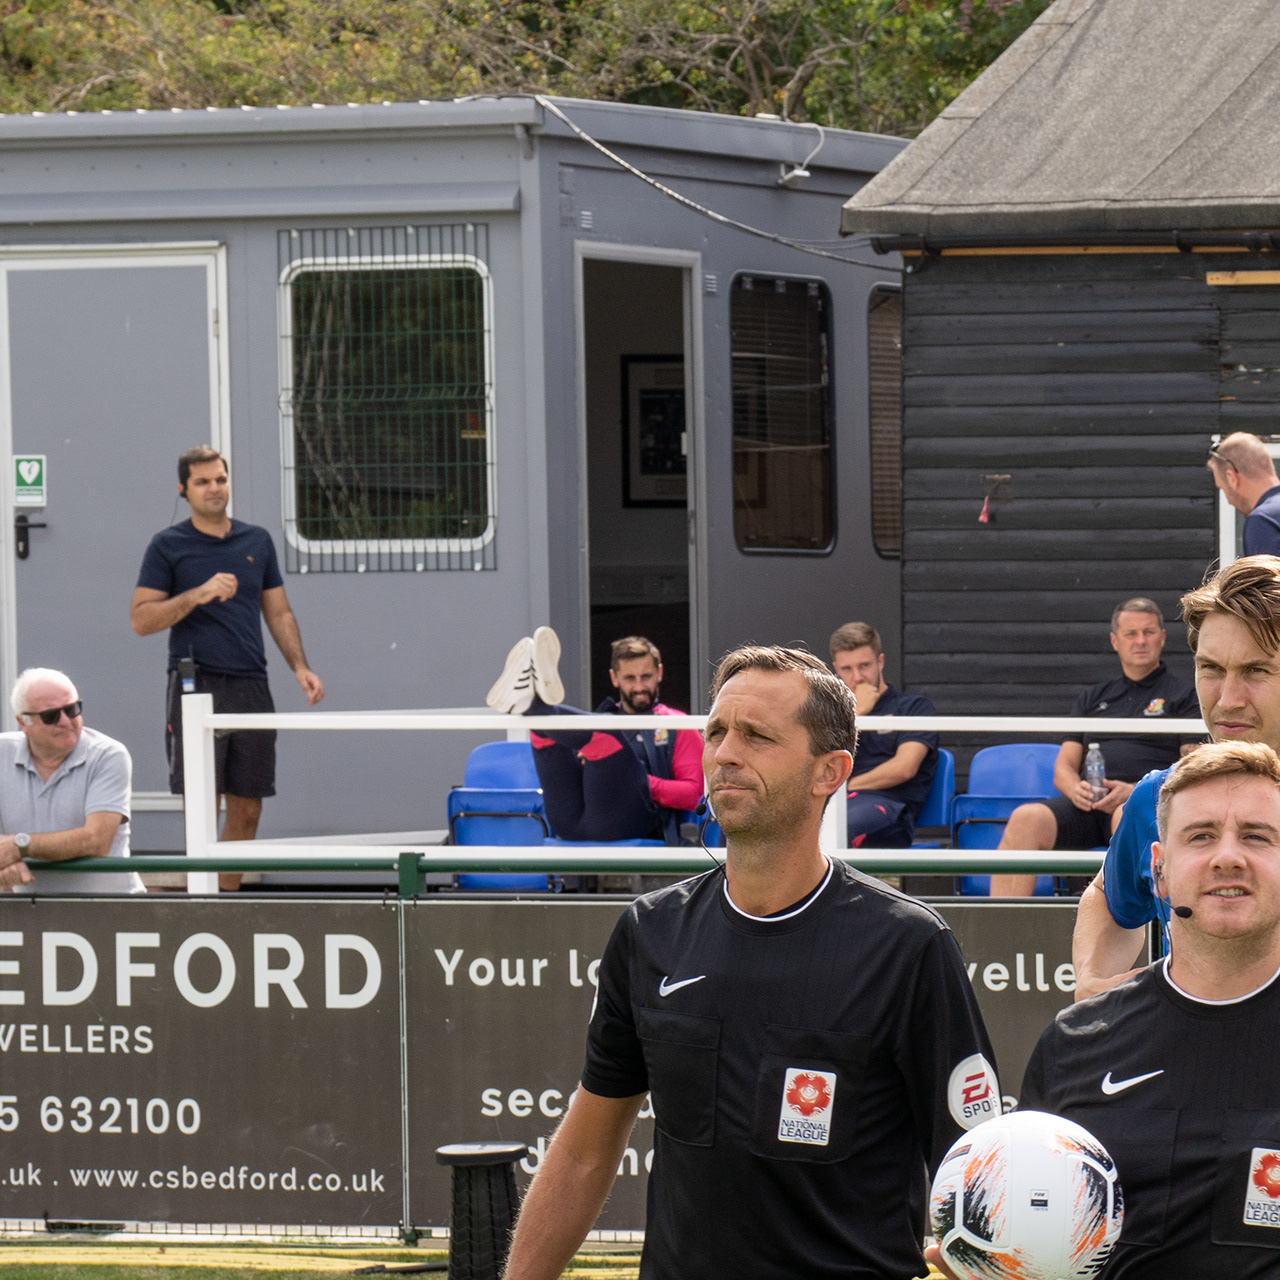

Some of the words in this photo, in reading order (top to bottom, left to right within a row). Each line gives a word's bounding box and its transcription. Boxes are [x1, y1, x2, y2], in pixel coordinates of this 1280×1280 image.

[434, 949, 548, 987] Your
[39, 1096, 201, 1135] 632100
[781, 1119, 828, 1132] NATIONAL
[780, 1128, 828, 1142] LEAGUE
[70, 1165, 386, 1193] www.csbedford.co.uk
